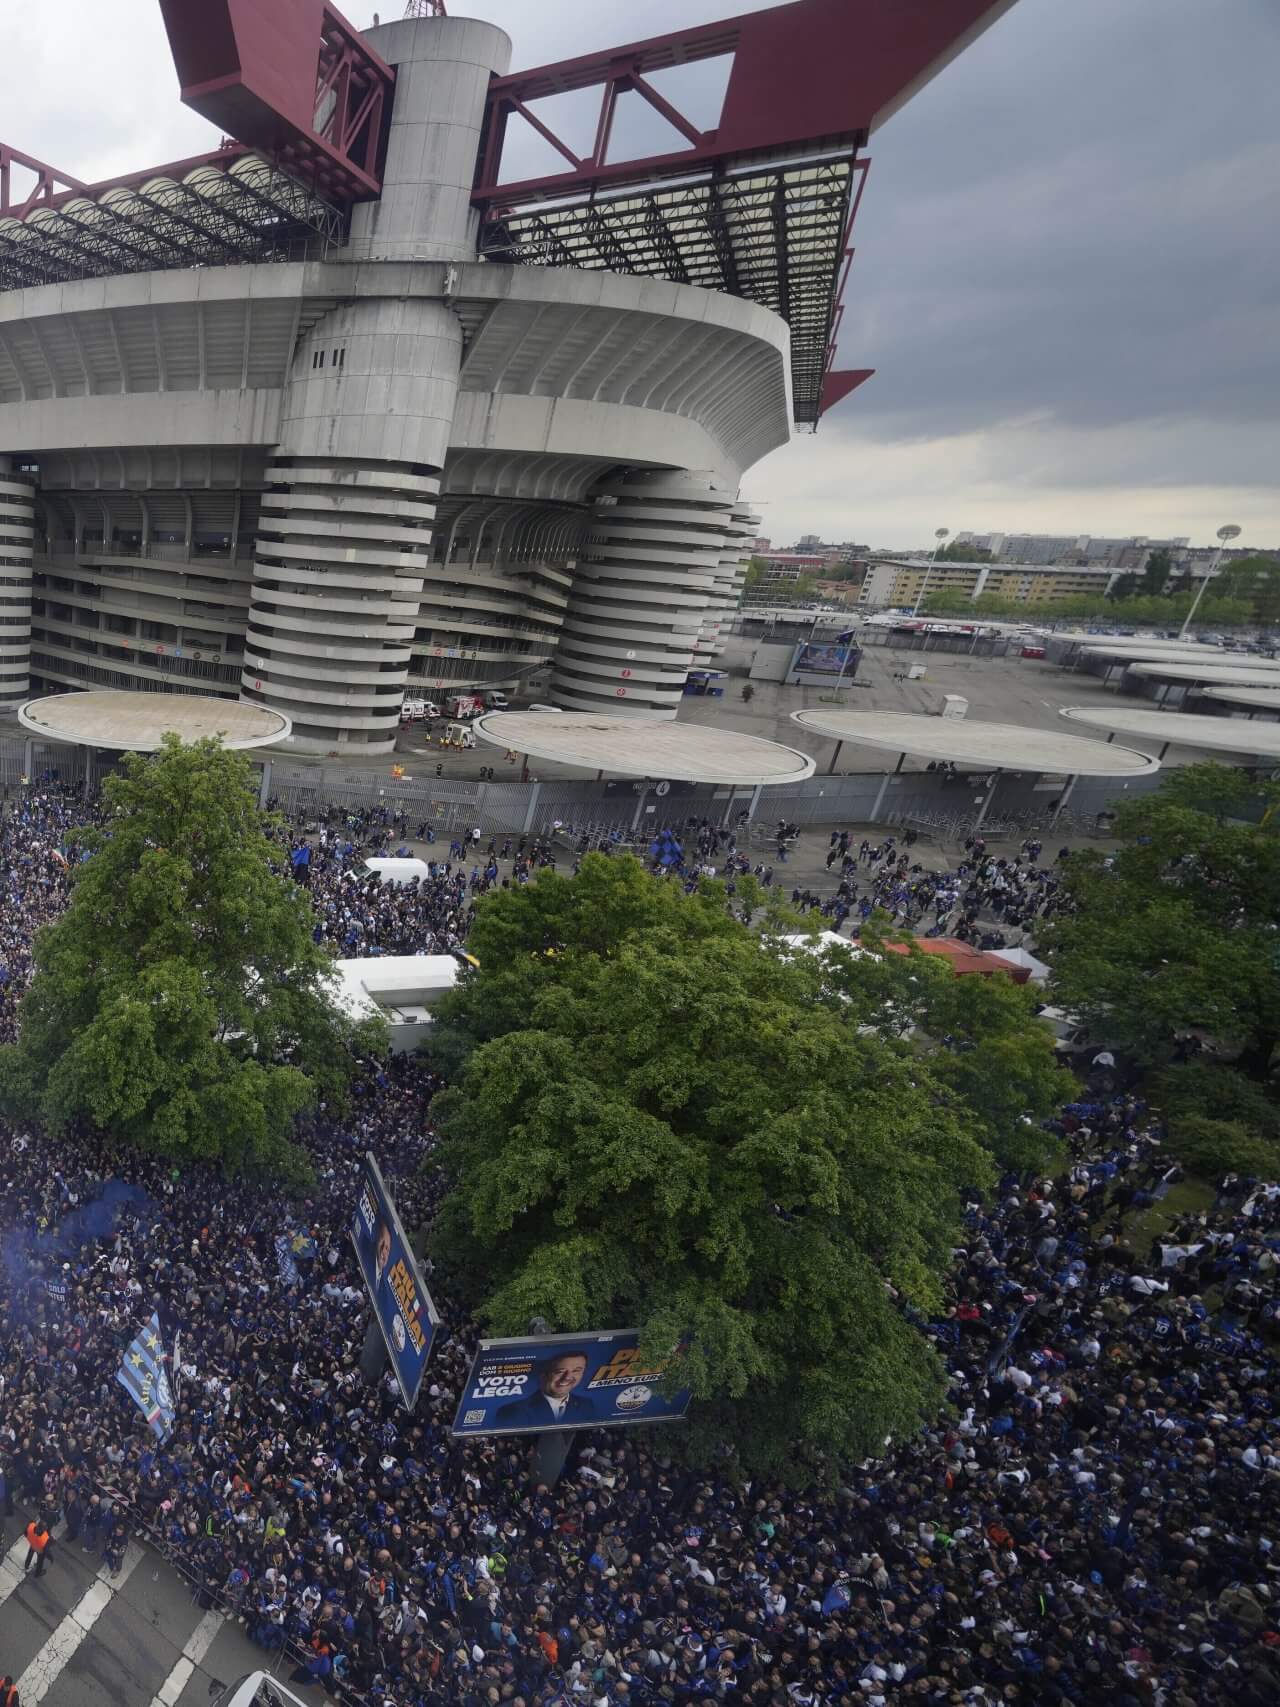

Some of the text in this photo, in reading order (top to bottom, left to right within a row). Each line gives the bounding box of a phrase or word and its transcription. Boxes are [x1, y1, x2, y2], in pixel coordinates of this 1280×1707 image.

[1155, 1323, 1168, 1334] 10
[478, 1374, 528, 1387] VOTO
[472, 1385, 522, 1398] LEGA
